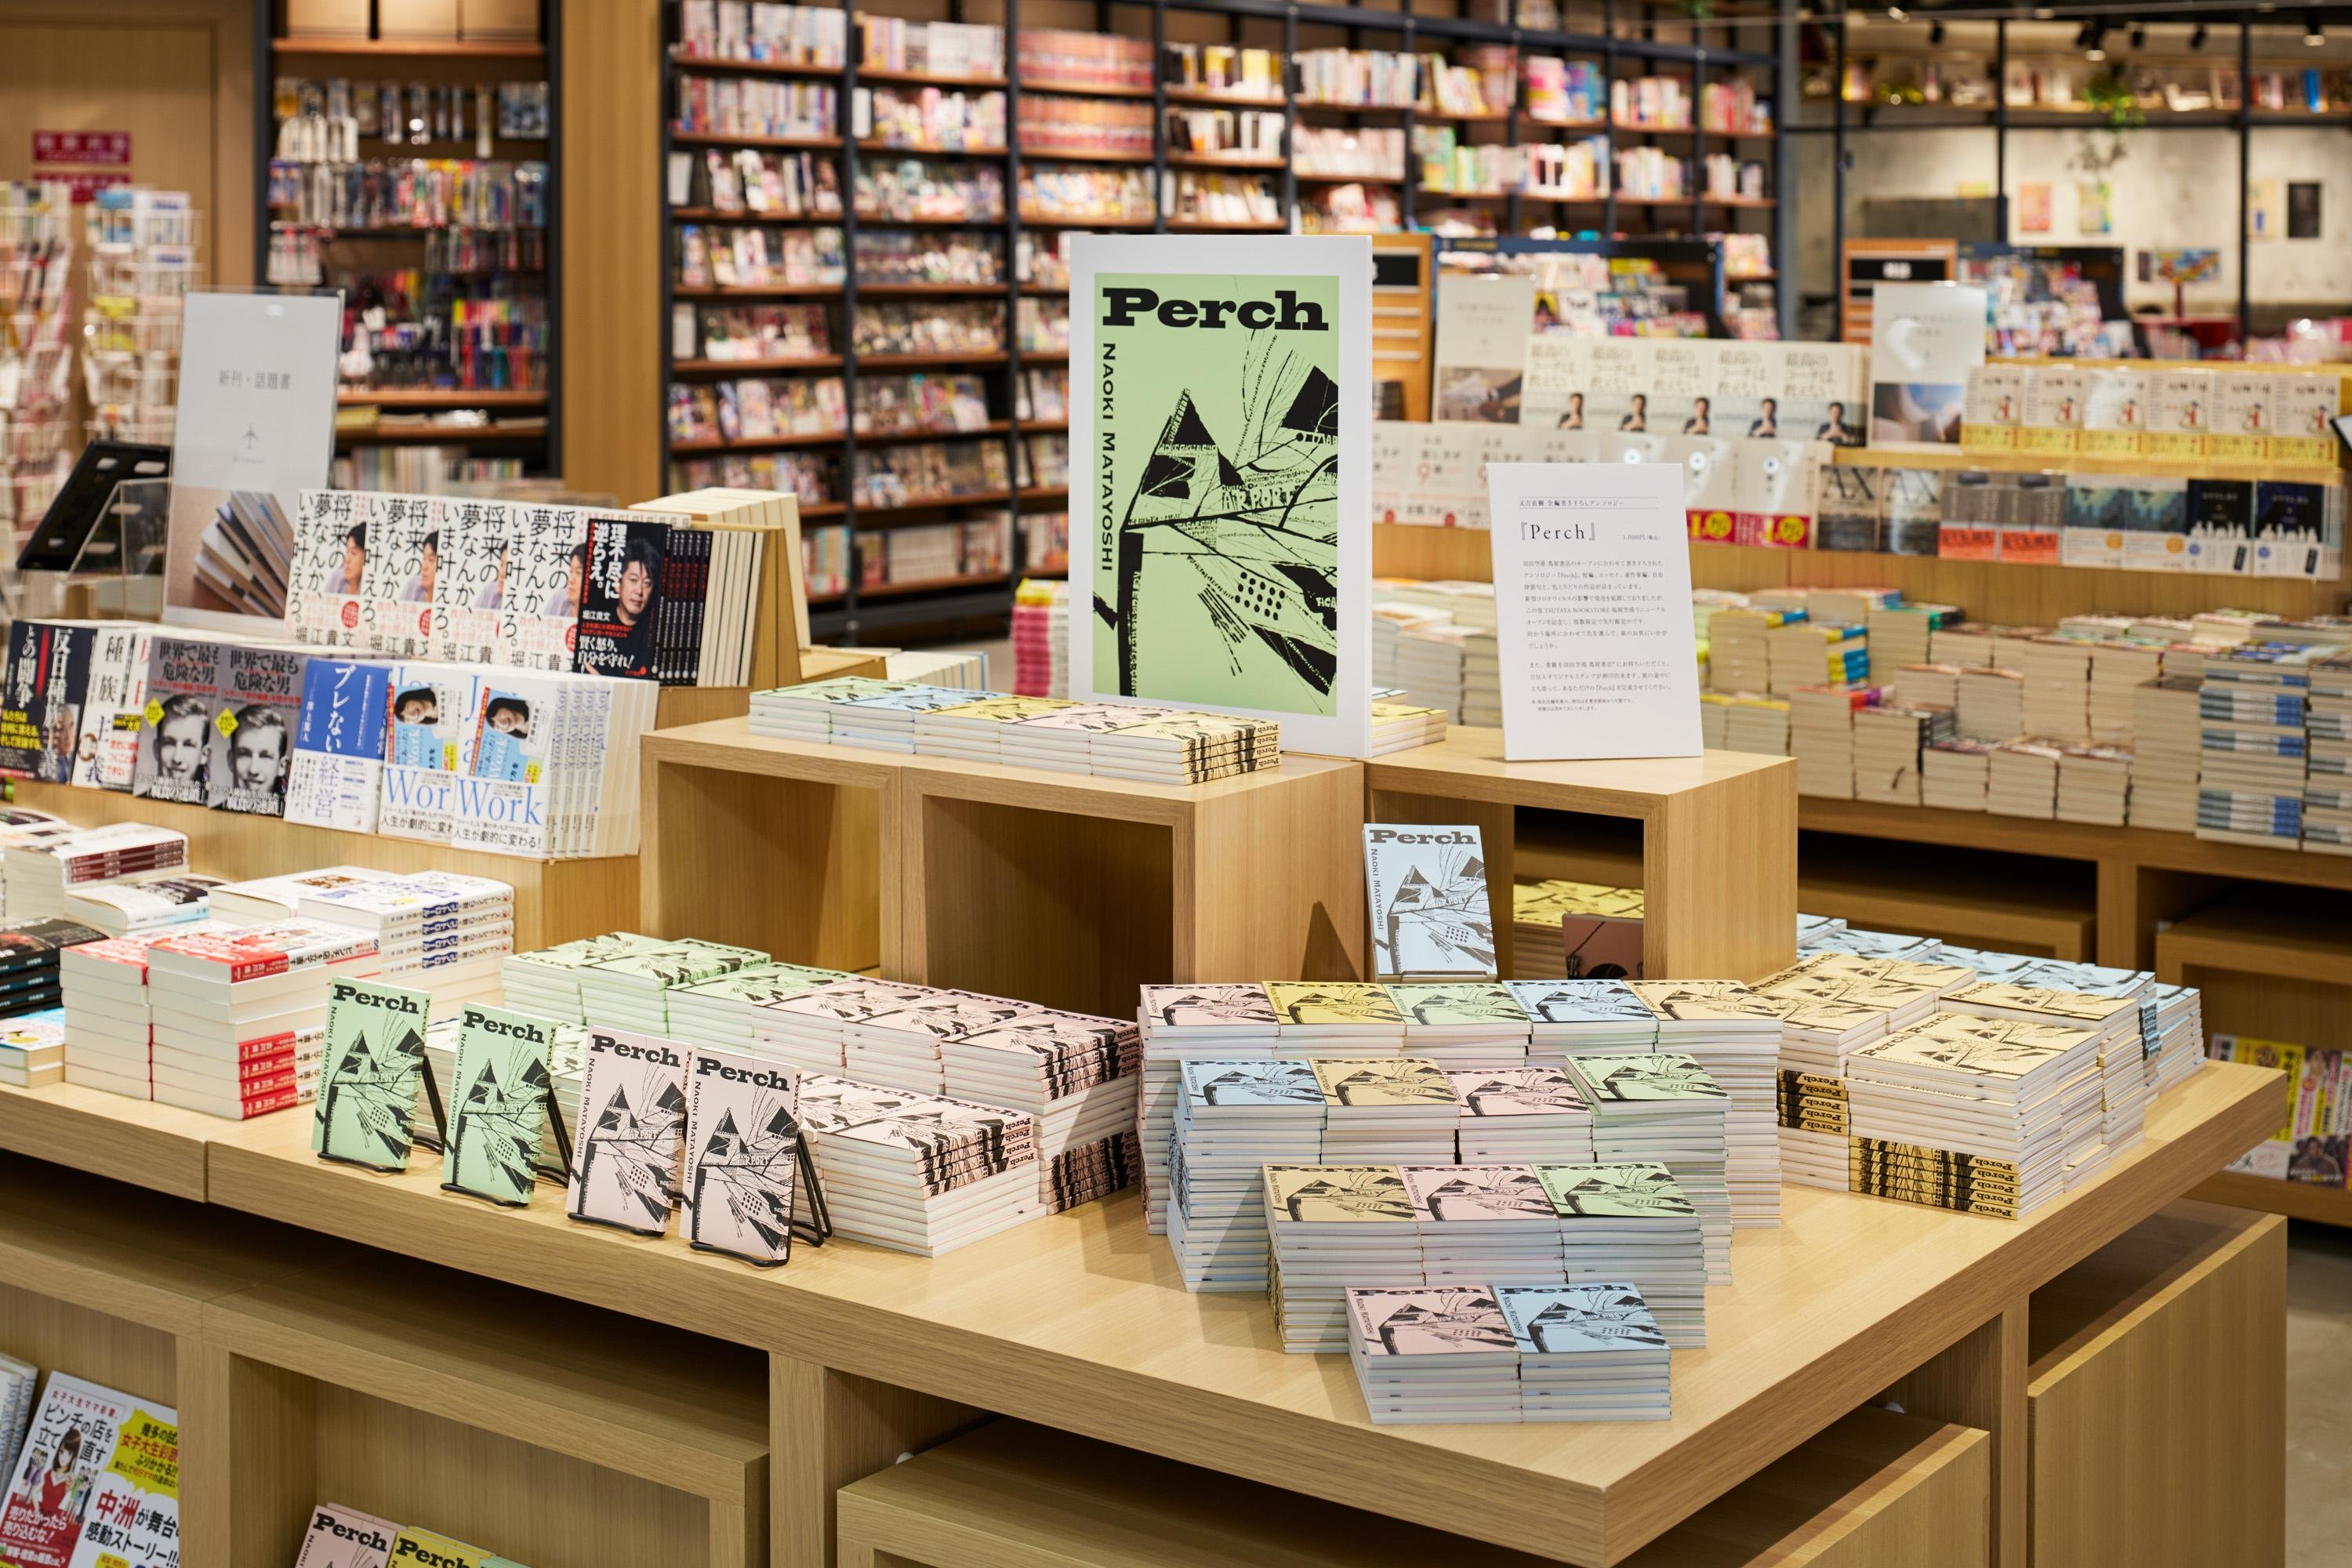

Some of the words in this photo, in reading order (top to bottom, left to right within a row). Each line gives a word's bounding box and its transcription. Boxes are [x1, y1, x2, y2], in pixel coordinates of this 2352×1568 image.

[1102, 287, 1330, 332] Perch
[1102, 343, 1116, 420] NAOKI
[1102, 432, 1116, 571] MATAYOSHI
[308, 494, 332, 598] 夢なんか、
[328, 495, 352, 568] 将来の
[404, 500, 429, 575] 将来の
[480, 506, 505, 583] 将来の
[1521, 521, 1595, 541] 『Perch』
[290, 493, 313, 622] いま叶えろ。
[362, 499, 386, 630] いま叶えろ。
[383, 499, 407, 606] 夢なんか、
[456, 504, 483, 615] 夢なんか、
[524, 509, 553, 621] 夢なんか、
[550, 510, 575, 590] 将来の
[590, 523, 610, 589] 逆らえ。
[604, 524, 628, 599] 理不尽に
[434, 504, 459, 639] いま叶えろ。
[503, 509, 529, 647] いま叶えろ。
[160, 641, 220, 666] 世界で最も
[230, 650, 299, 675] 世界で最も
[162, 663, 215, 684] 危険な男
[234, 671, 290, 695] 危険な男
[325, 665, 357, 753] ブレない
[1257, 735, 1277, 744] Perch
[1257, 746, 1277, 755] Perch
[1258, 757, 1279, 767] Perch
[456, 776, 543, 826] Work
[454, 829, 542, 849] 人生が劇的に変わる!
[1369, 829, 1477, 844] Perch
[1374, 880, 1384, 930] MATAYOSHI
[744, 957, 767, 968] Perch
[1792, 953, 1839, 974] Perch
[857, 978, 936, 995] Perch
[1750, 971, 1796, 992] Perch
[1951, 982, 1997, 998] Perch
[333, 984, 419, 1014] Perch
[945, 991, 1030, 1010] Perch
[325, 1007, 337, 1038] NAOKI
[463, 1010, 545, 1044] Perch
[1037, 1010, 1128, 1028] Perch
[1907, 1014, 1957, 1035] Perch
[456, 1033, 466, 1071] NAOKI
[546, 1027, 556, 1066] Perch
[590, 1034, 681, 1068] Perch
[1860, 1034, 1912, 1057] Perch
[320, 1043, 332, 1100] MATAYOSHI
[585, 1058, 595, 1092] NAOKI
[682, 1050, 692, 1091] Perch
[696, 1057, 789, 1091] Perch
[1803, 1075, 1839, 1087] Perch
[449, 1072, 462, 1130] MATAYOSHI
[692, 1081, 702, 1116] NAOKI
[793, 1073, 802, 1115] Perch
[829, 1079, 916, 1101] Perch
[1806, 1085, 1842, 1097] Perch
[1806, 1099, 1841, 1110] Perch
[930, 1097, 1018, 1118] Perch
[1806, 1110, 1842, 1122] Perch
[577, 1097, 590, 1157] MATAYOSHI
[1006, 1117, 1031, 1131] Perch
[1006, 1129, 1030, 1142] Perch
[1806, 1121, 1842, 1133] Perch
[687, 1121, 699, 1184] MATAYOSHI
[1006, 1142, 1030, 1155] Perch
[1010, 1152, 1035, 1166] Perch
[1975, 1158, 2013, 1171] Perch
[1976, 1169, 2015, 1182] Perch
[1976, 1180, 2014, 1194] Perch
[1976, 1192, 2013, 1205] Perch
[1975, 1204, 2012, 1217] Perch
[1352, 1287, 1486, 1297] Perch
[1499, 1284, 1632, 1294] Perch
[44, 1403, 113, 1443] ピンチの店を
[34, 1426, 62, 1450] 立て
[80, 1440, 107, 1465] 直す
[96, 1490, 179, 1539] 中洲が舞台
[313, 1512, 387, 1552] Perch
[299, 1534, 314, 1567] NAOKI
[395, 1537, 473, 1568] Perch
